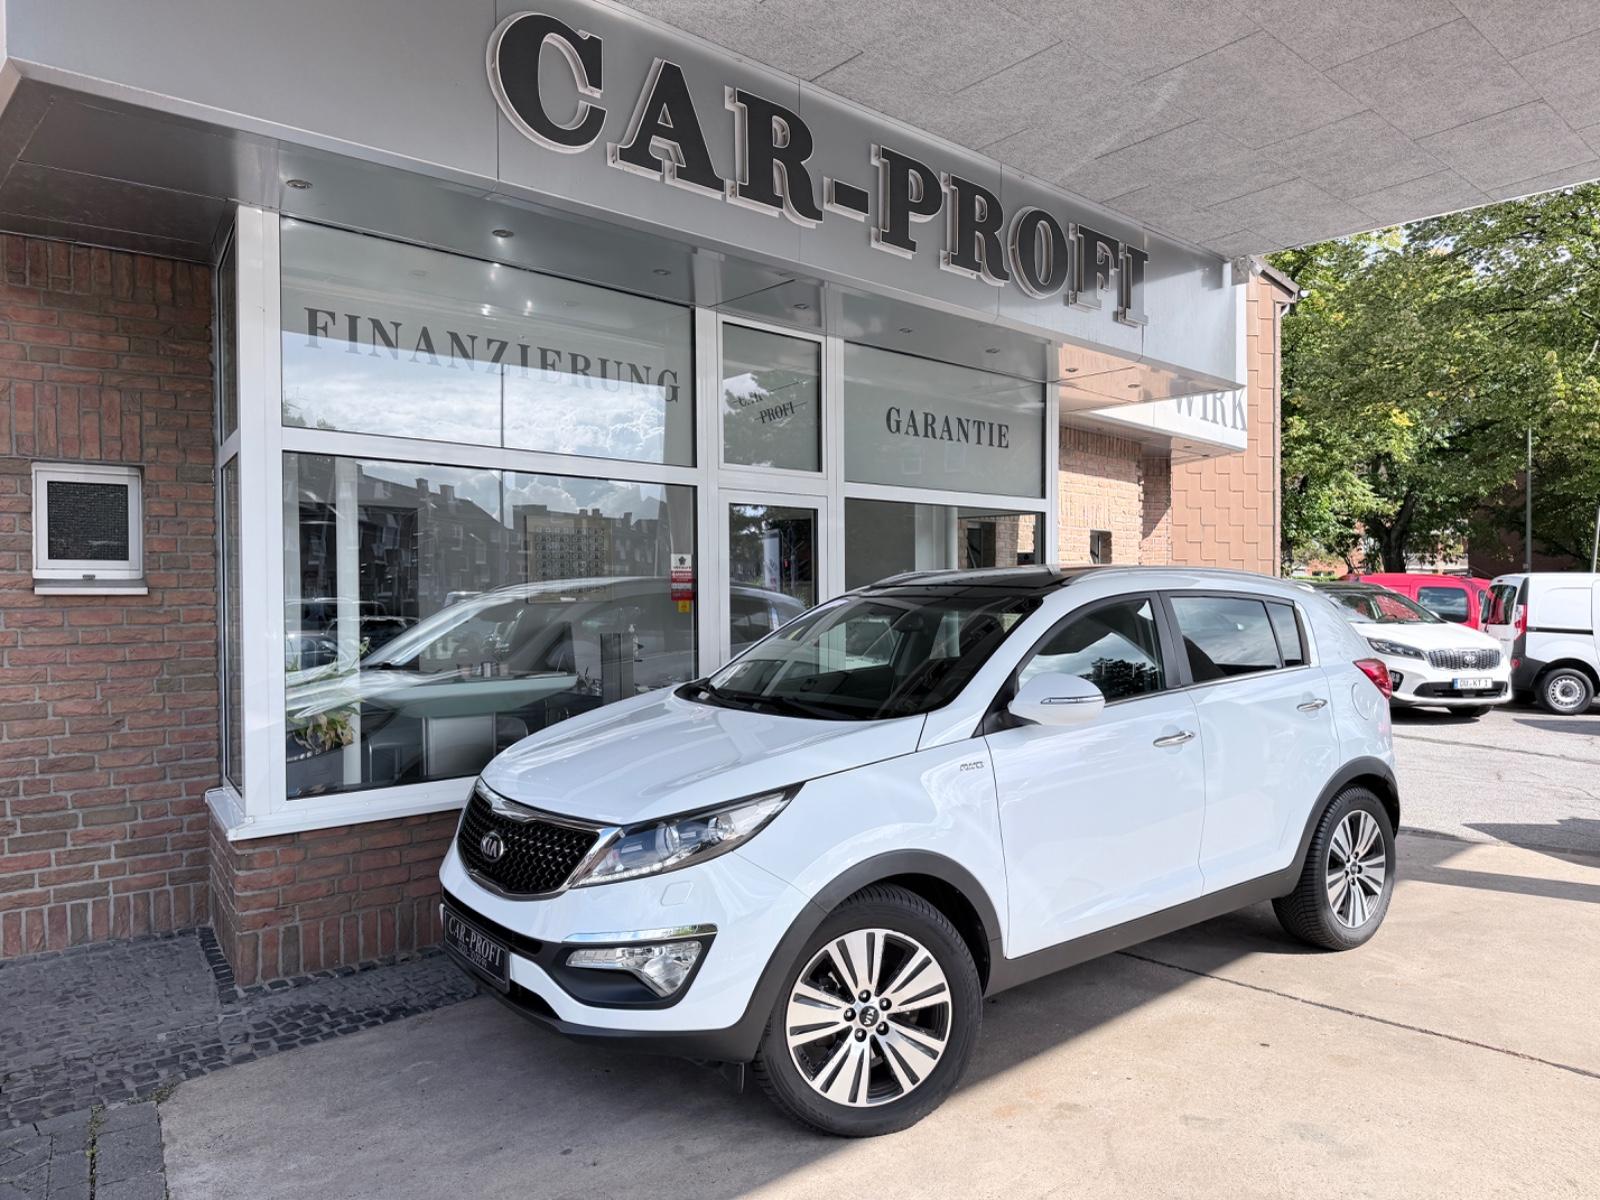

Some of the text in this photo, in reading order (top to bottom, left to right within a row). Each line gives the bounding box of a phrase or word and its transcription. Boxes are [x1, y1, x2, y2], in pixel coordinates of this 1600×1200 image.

[486, 10, 1149, 325] CAR-PROFI
[304, 307, 681, 403] FINANZIERUNG
[759, 401, 795, 424] PROFI
[886, 406, 1010, 449] GARANTIE
[481, 834, 497, 857] KIA
[448, 916, 501, 966] CAR-PROFI
